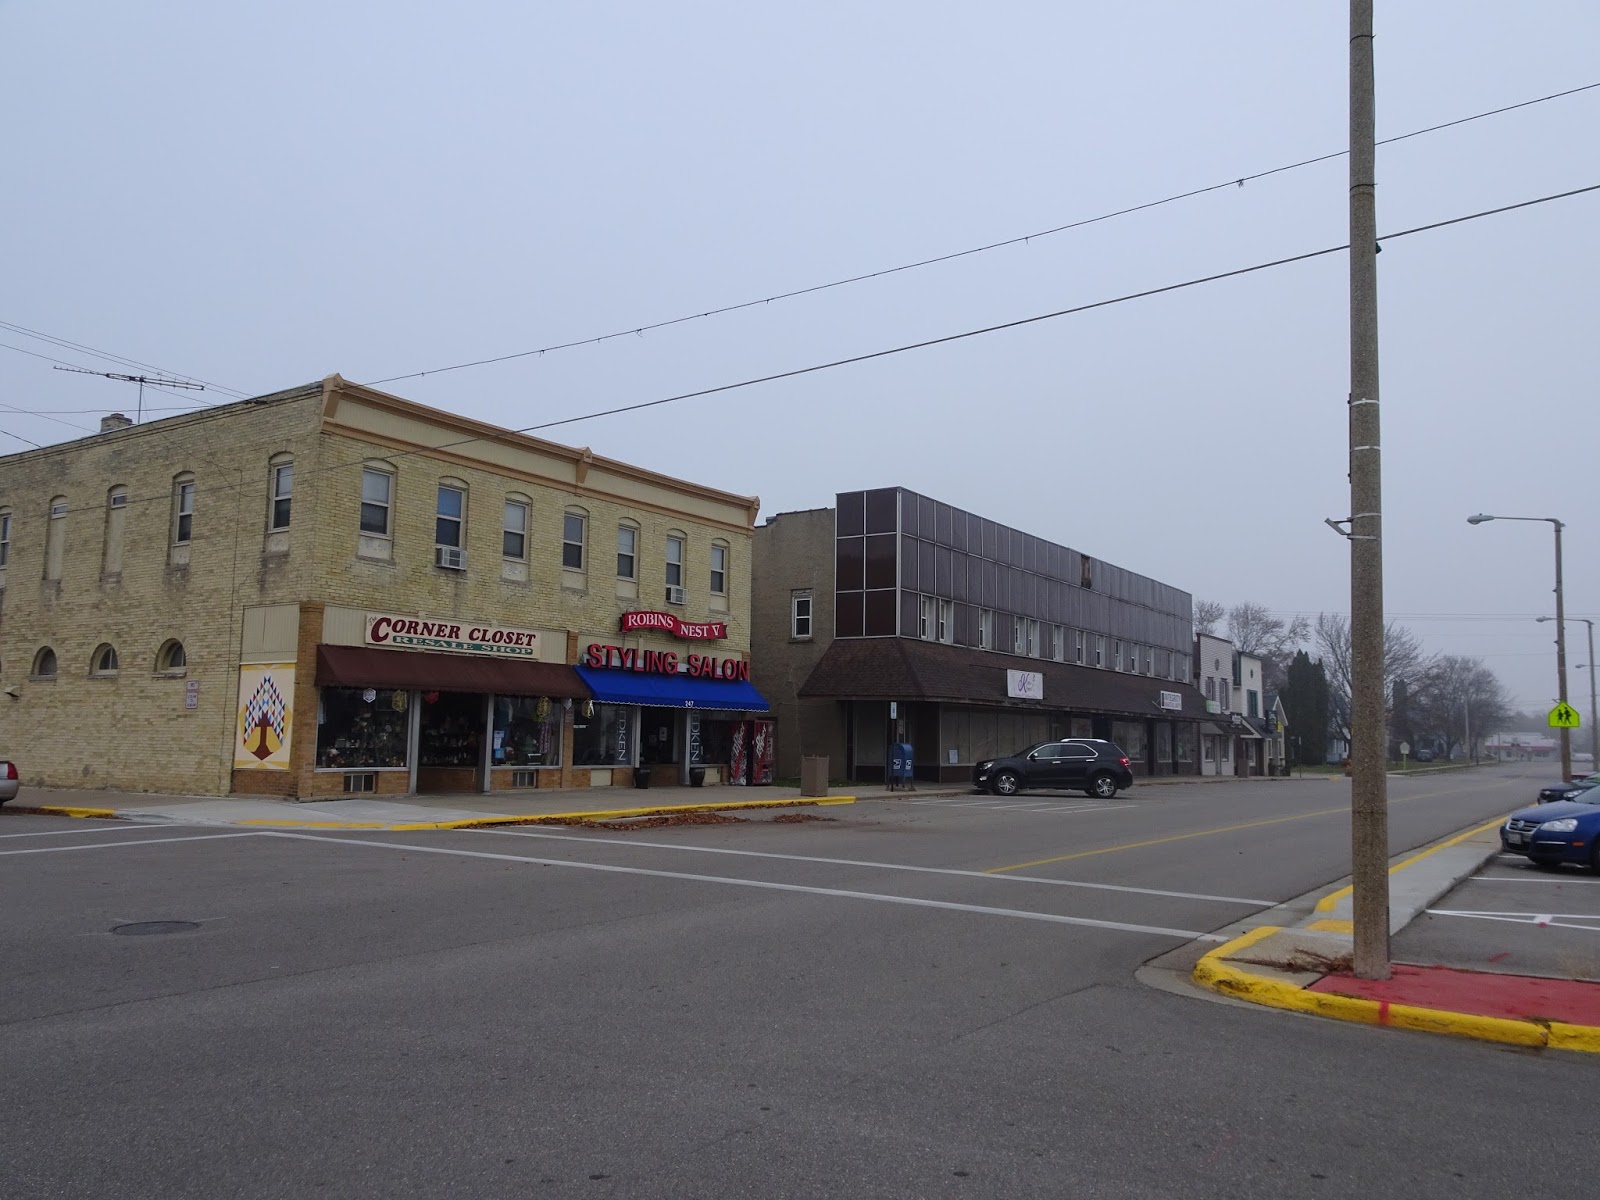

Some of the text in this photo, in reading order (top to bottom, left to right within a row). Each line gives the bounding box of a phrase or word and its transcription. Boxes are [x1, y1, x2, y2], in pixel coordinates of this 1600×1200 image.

[627, 613, 674, 628] ROBINS
[371, 617, 536, 647] CORNER CLOSET
[680, 624, 721, 637] NEST V
[395, 635, 533, 655] RESALE SHOP
[587, 643, 750, 681] STYLING SALON
[684, 700, 694, 708] 247
